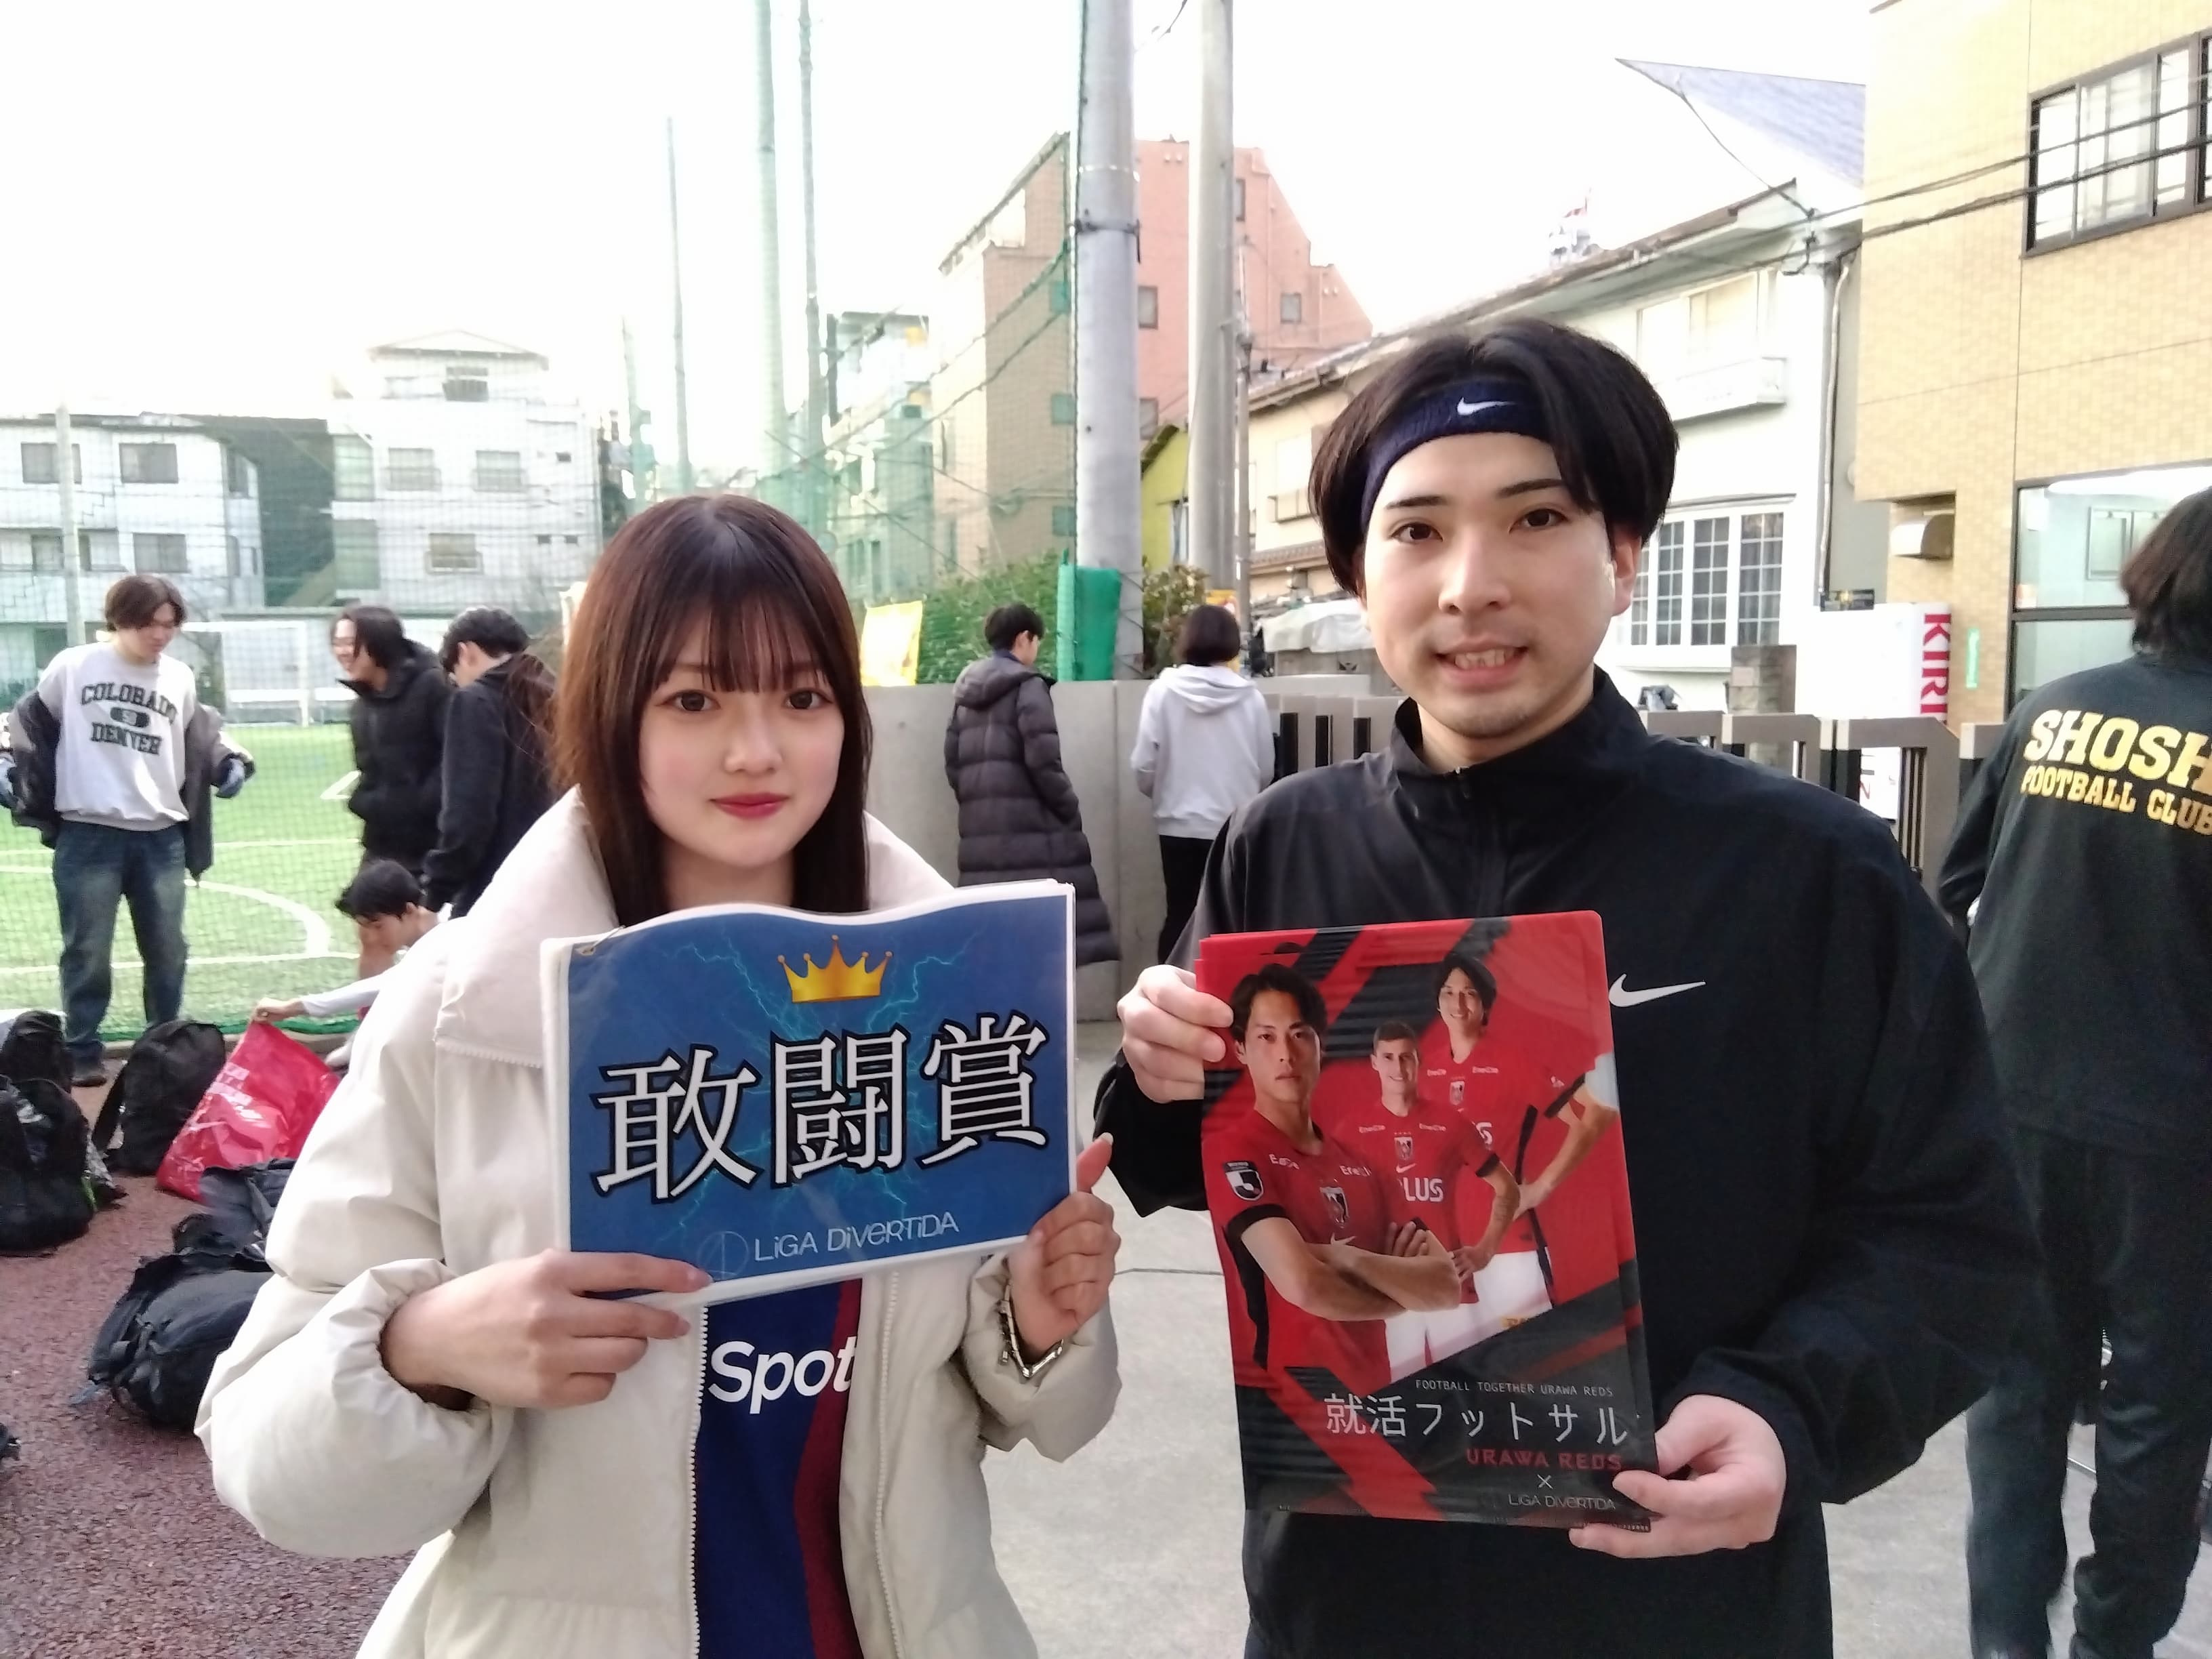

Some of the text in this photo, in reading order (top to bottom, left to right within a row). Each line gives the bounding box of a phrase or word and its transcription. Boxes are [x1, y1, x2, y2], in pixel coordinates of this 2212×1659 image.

[1920, 613, 1951, 724] KIRI
[90, 722, 162, 755] DENVER
[2023, 709, 2212, 796] SHOSH
[2020, 765, 2212, 836] FOOTBALL CLUB
[594, 1010, 1049, 1204] 敢闘賞
[1398, 1177, 1444, 1202] LUS
[708, 1336, 857, 1414] Spot
[1415, 1379, 1613, 1397] FOOTBALL TOGETHER URAWA REDS
[1324, 1392, 1628, 1445] 就活フットサル
[1467, 1448, 1622, 1471] URAWA REDS
